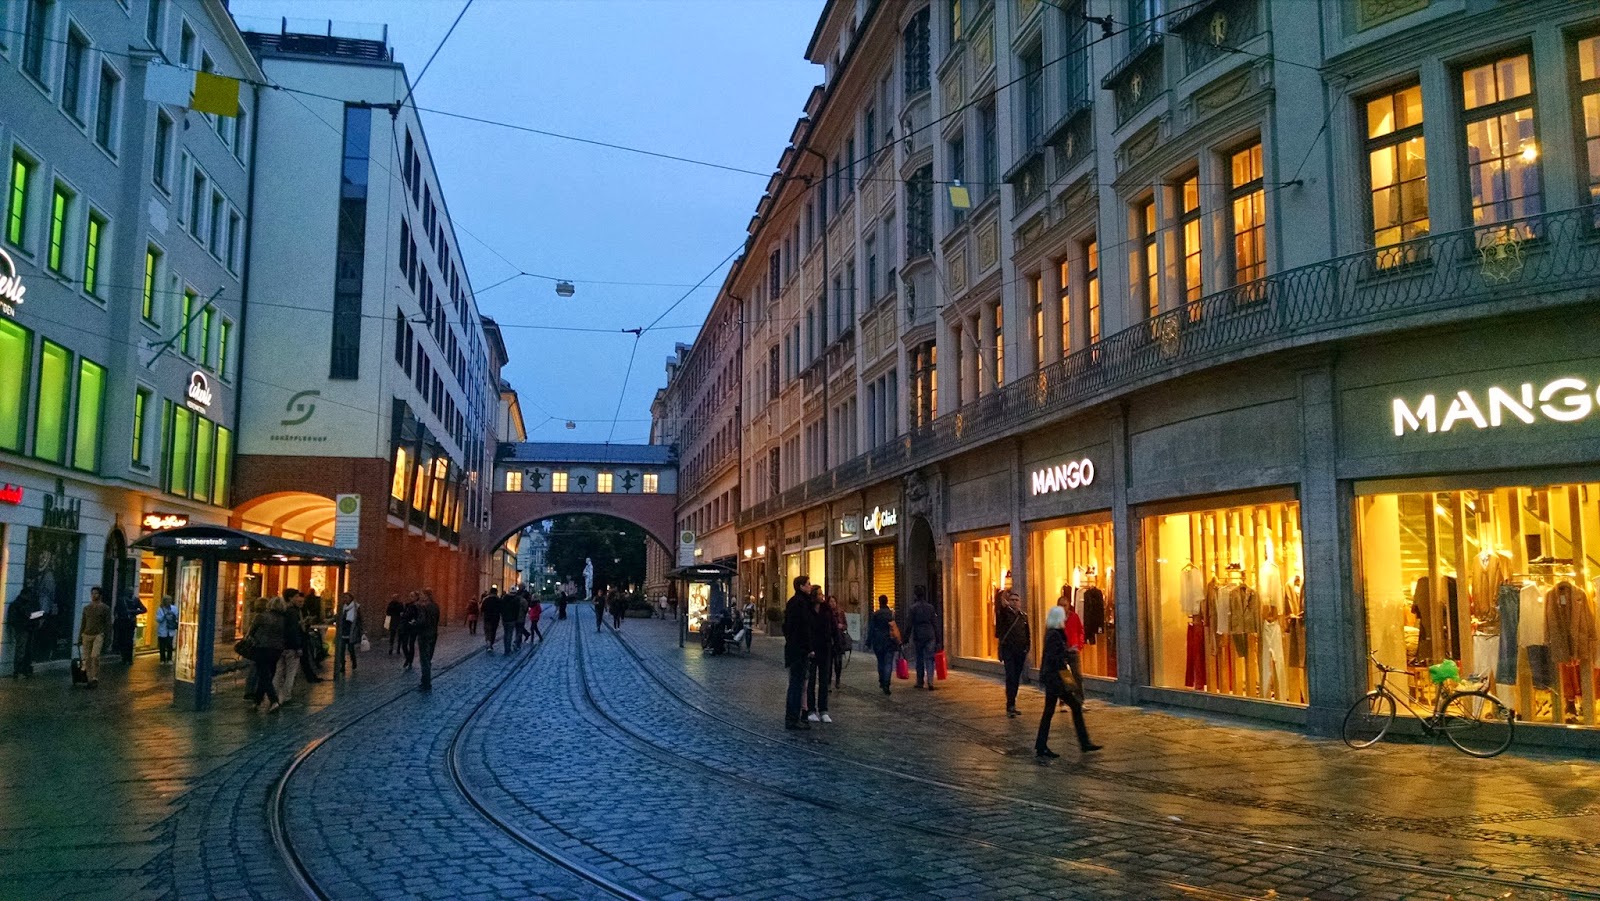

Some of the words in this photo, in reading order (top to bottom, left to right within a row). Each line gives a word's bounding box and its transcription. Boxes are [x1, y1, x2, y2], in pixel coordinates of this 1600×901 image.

[1393, 378, 1600, 436] MANG
[1032, 458, 1094, 495] MANGO
[175, 538, 228, 546] Theatinerstraße
